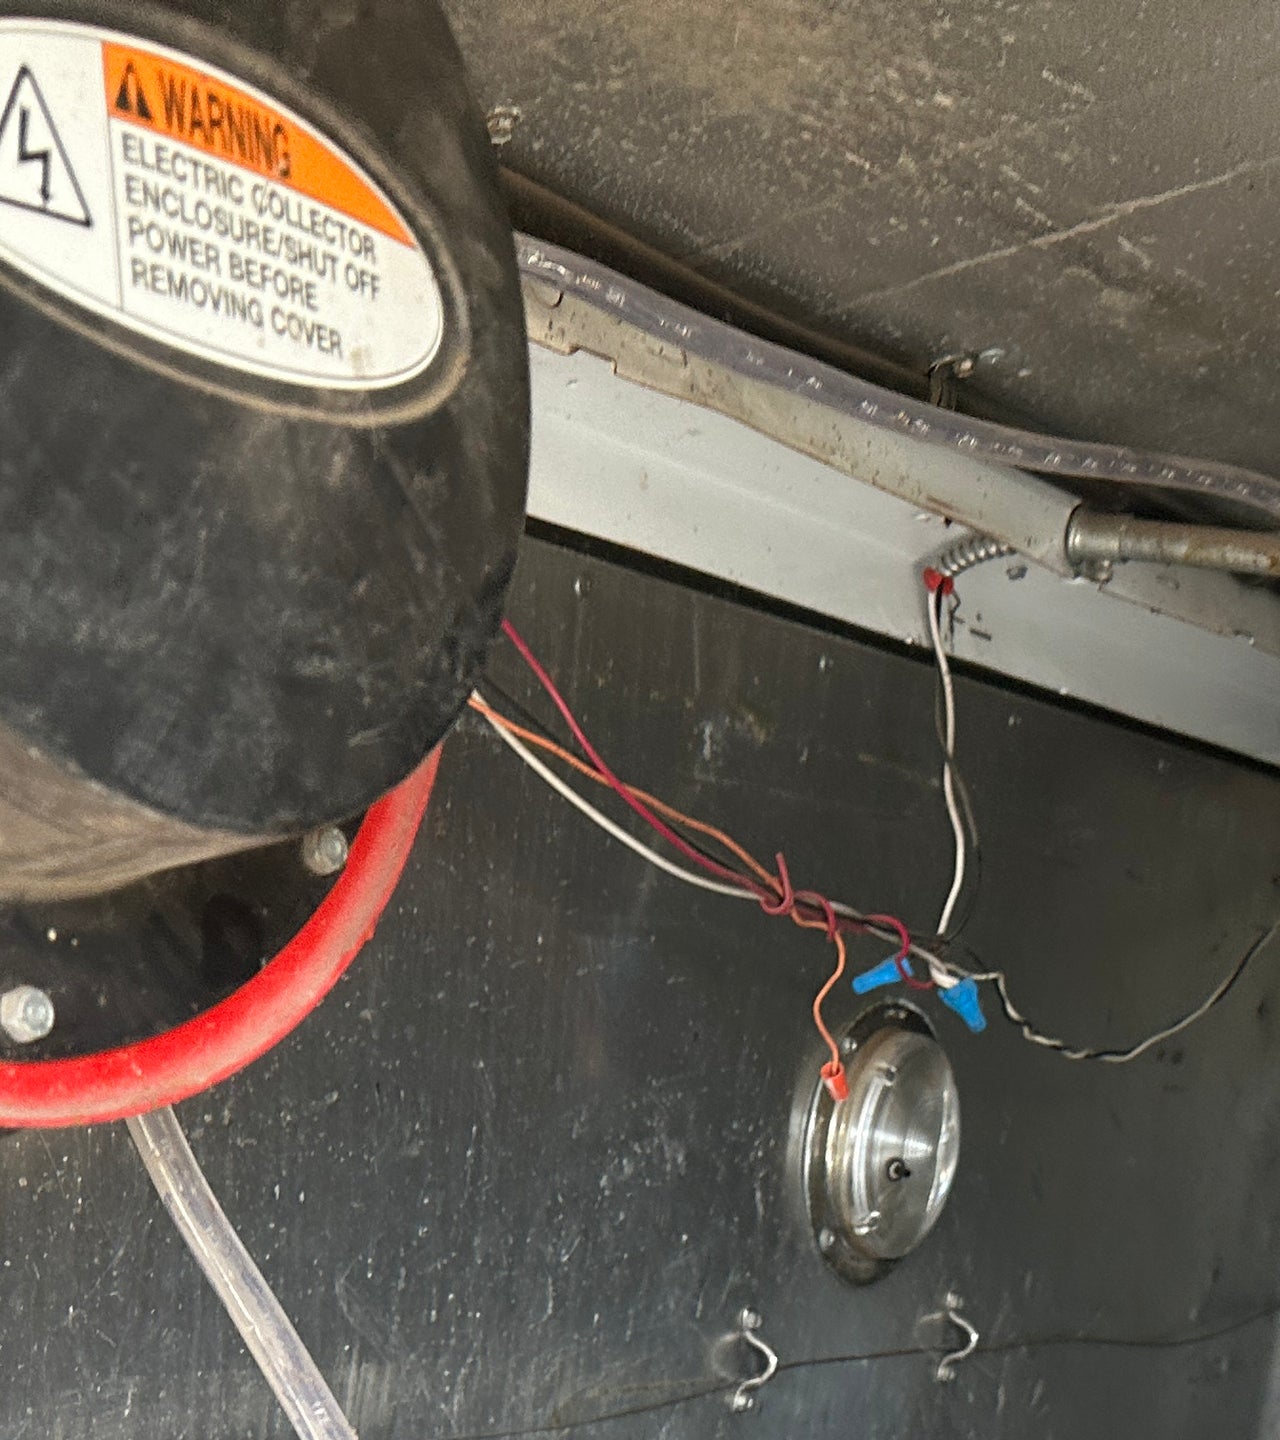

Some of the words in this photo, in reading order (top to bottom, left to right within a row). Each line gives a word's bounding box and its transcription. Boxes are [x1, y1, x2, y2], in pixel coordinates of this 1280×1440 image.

[158, 68, 292, 180] WARNING
[121, 131, 246, 207] ELECTRIC
[250, 182, 378, 261] COLLECTOR
[125, 178, 340, 280] ENCLOSURE/SHUT
[343, 261, 381, 300] OFF
[127, 219, 222, 276] POWER
[228, 257, 319, 312] BEFORE
[130, 260, 264, 329] REMOVING
[271, 311, 343, 359] COVER
